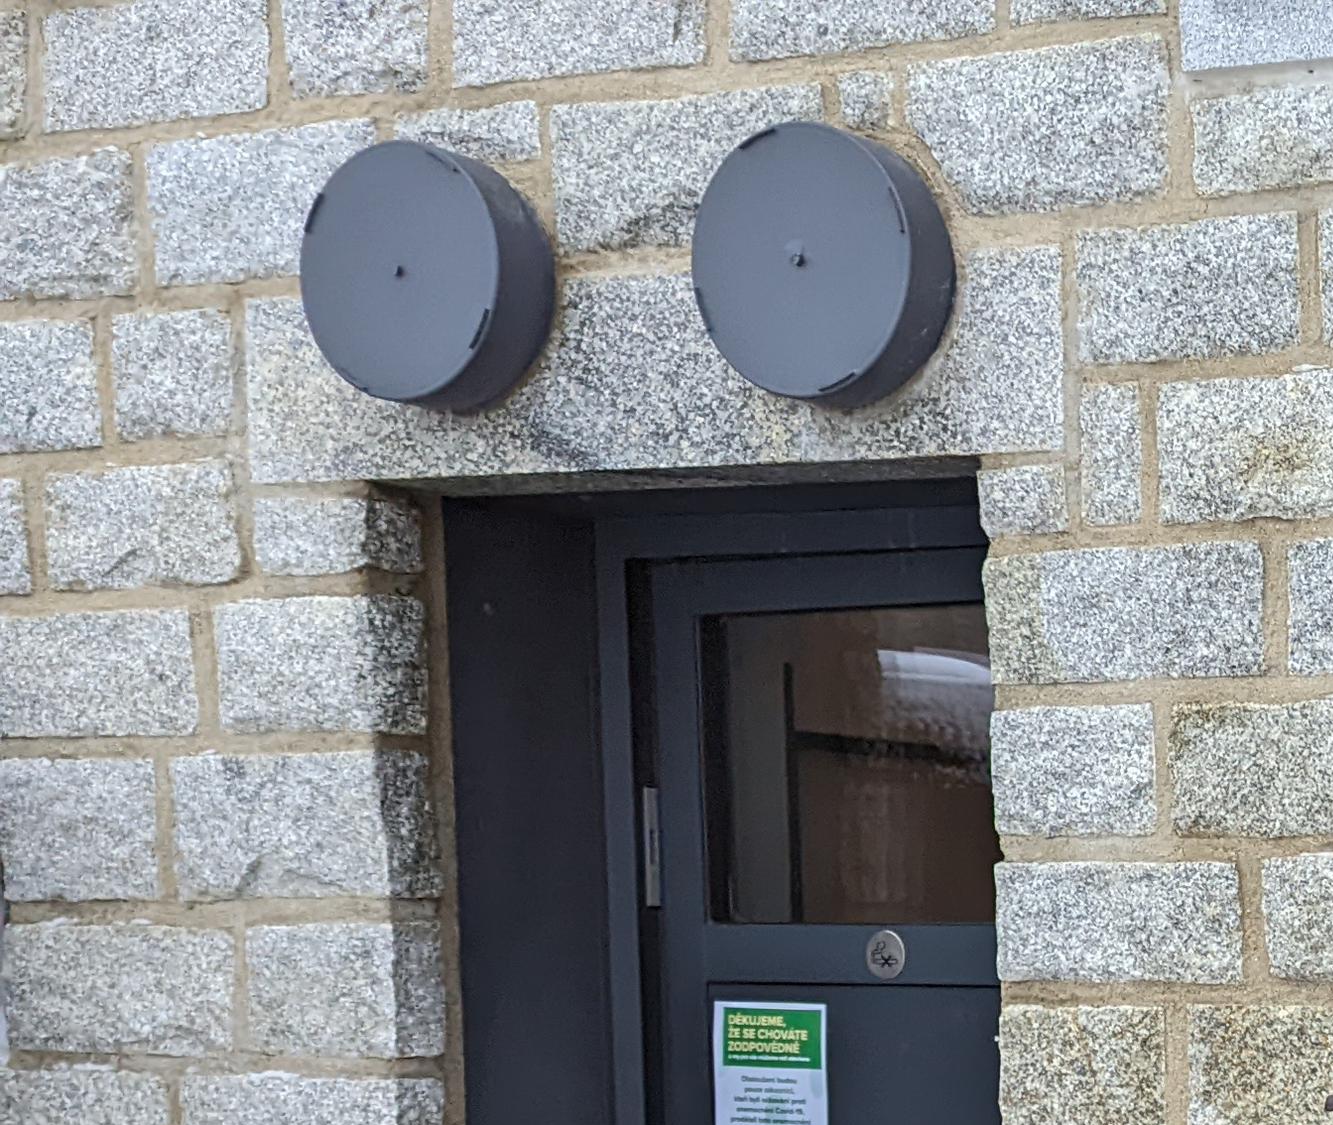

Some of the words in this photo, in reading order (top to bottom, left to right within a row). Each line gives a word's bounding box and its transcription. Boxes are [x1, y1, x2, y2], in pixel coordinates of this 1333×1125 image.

[728, 1013, 787, 1027] DĚKUJEME,
[742, 1028, 756, 1039] SE
[757, 1027, 808, 1040] CHOVÁTE
